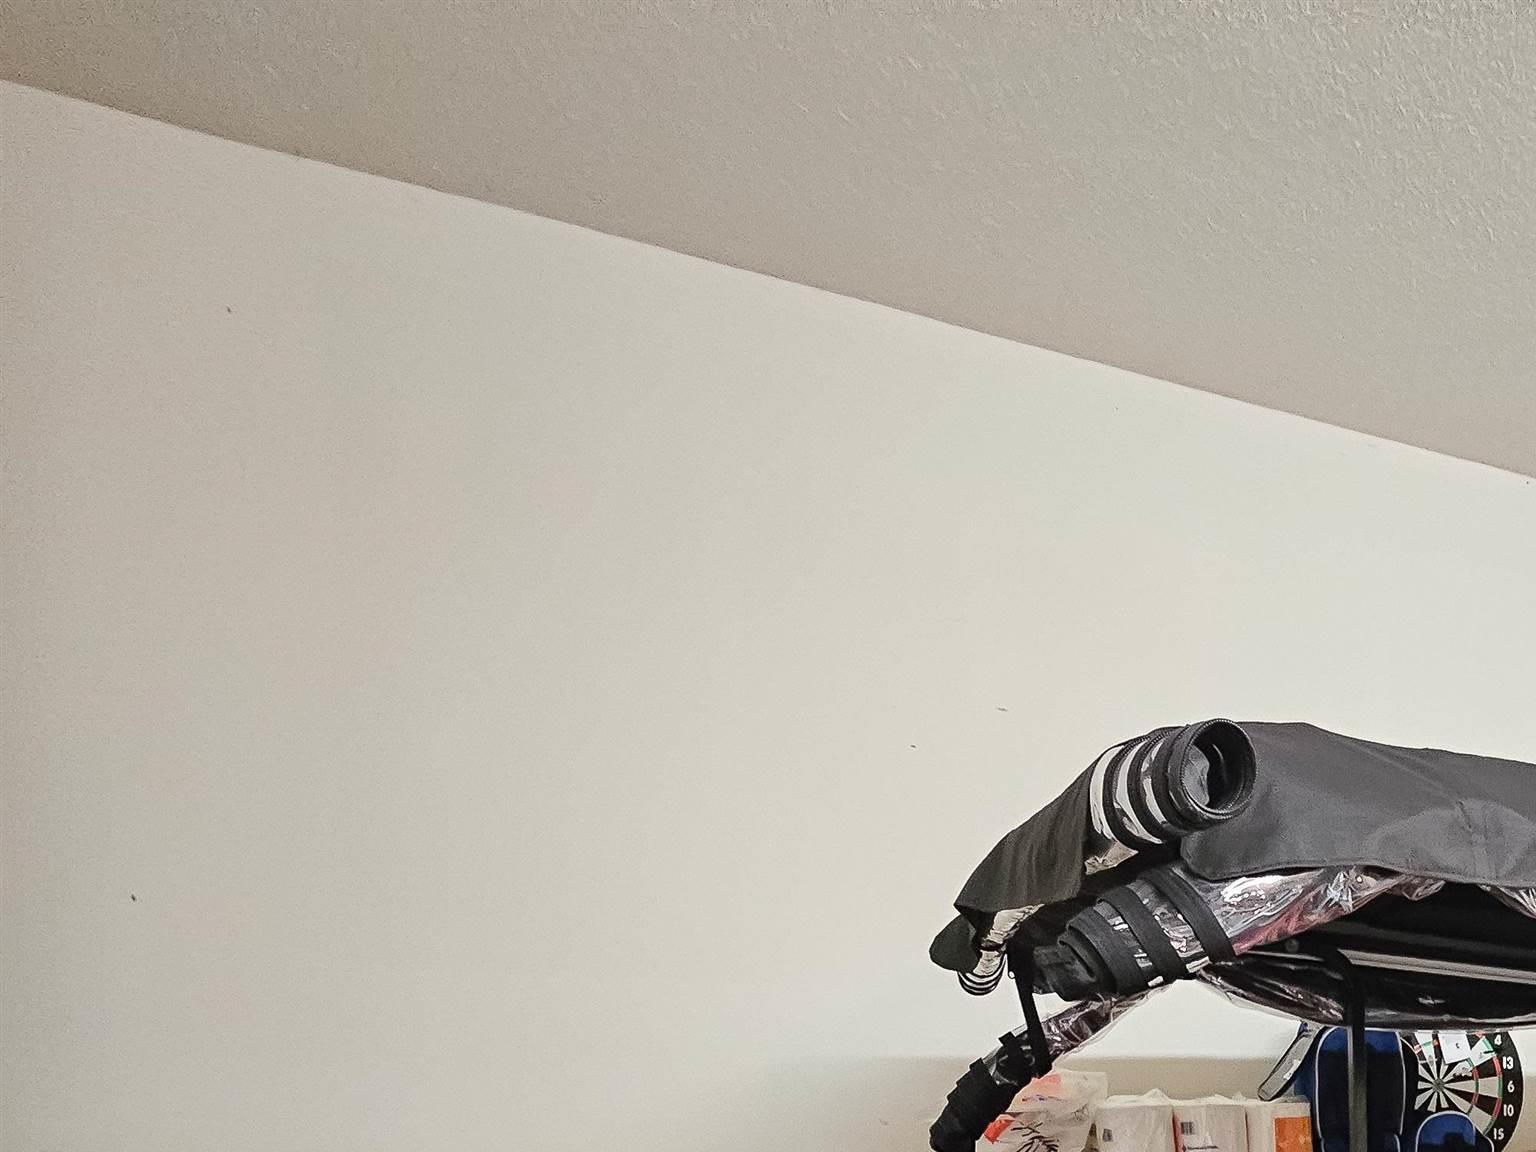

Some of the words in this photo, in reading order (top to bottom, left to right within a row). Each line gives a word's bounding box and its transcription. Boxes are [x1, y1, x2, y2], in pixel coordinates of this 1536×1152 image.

[1494, 1034, 1502, 1046] 4
[1502, 1056, 1514, 1069] 13
[1507, 1081, 1515, 1093] 6
[1503, 1105, 1514, 1117] 10
[1493, 1128, 1504, 1140] 15
